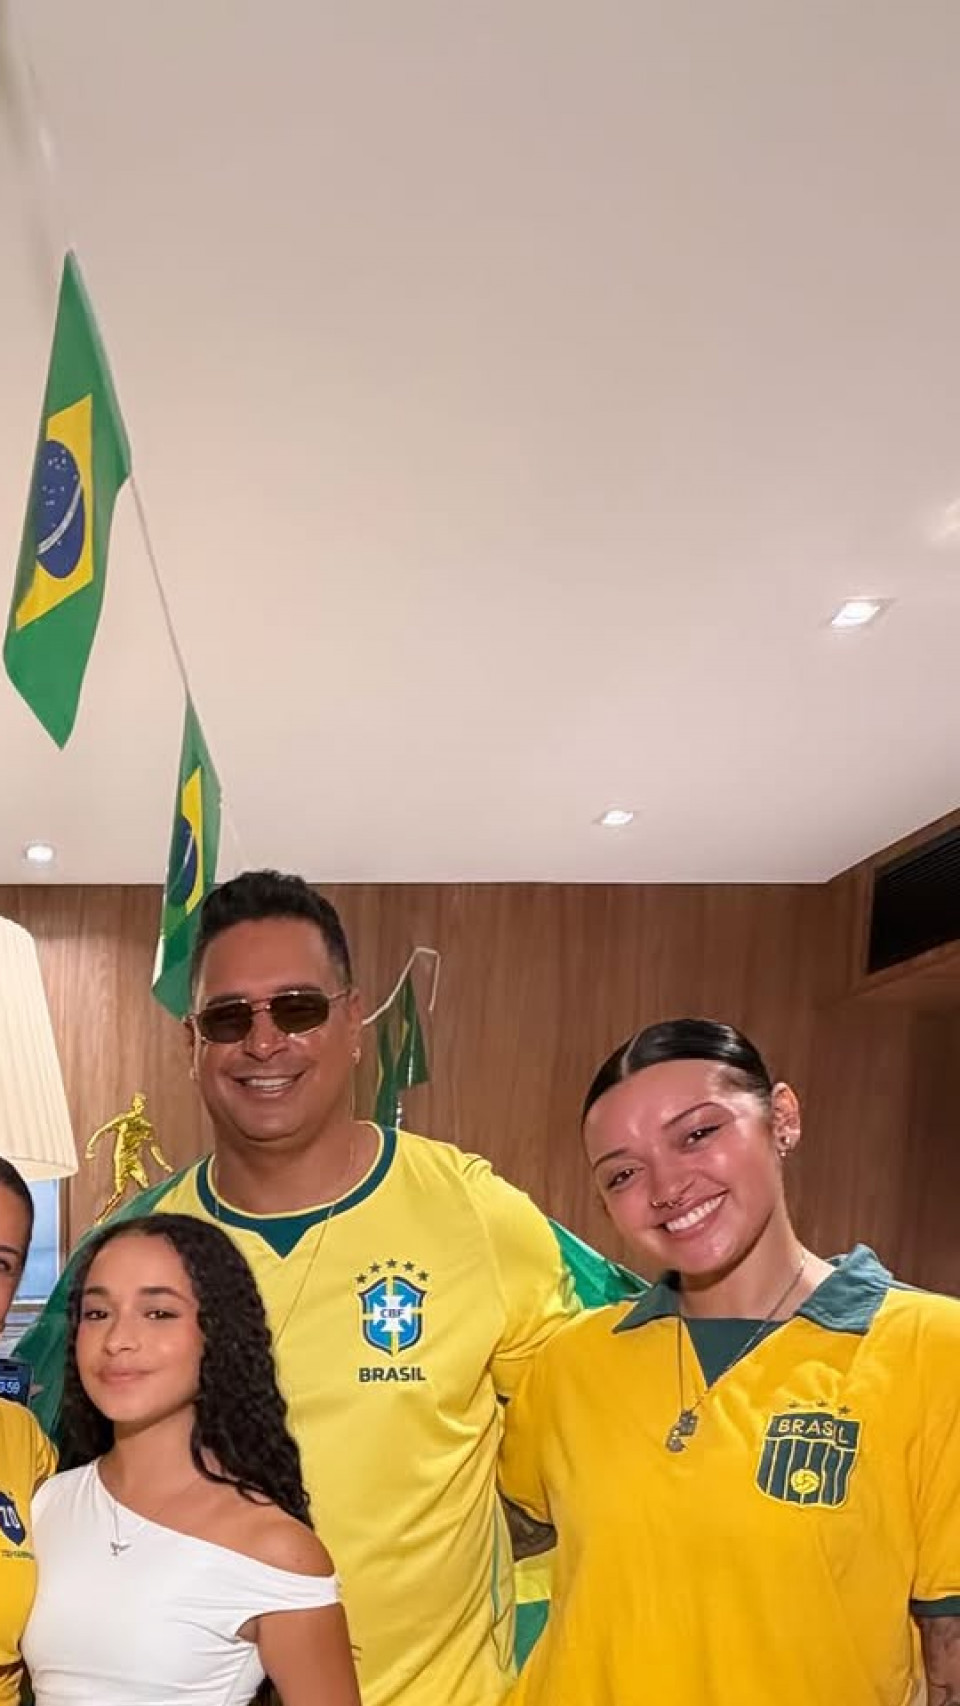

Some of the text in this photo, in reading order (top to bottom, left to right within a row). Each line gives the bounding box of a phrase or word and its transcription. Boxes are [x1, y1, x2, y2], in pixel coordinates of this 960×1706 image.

[380, 1308, 404, 1318] CBF
[359, 1367, 425, 1382] BRASIL
[778, 1418, 848, 1444] BRASIL
